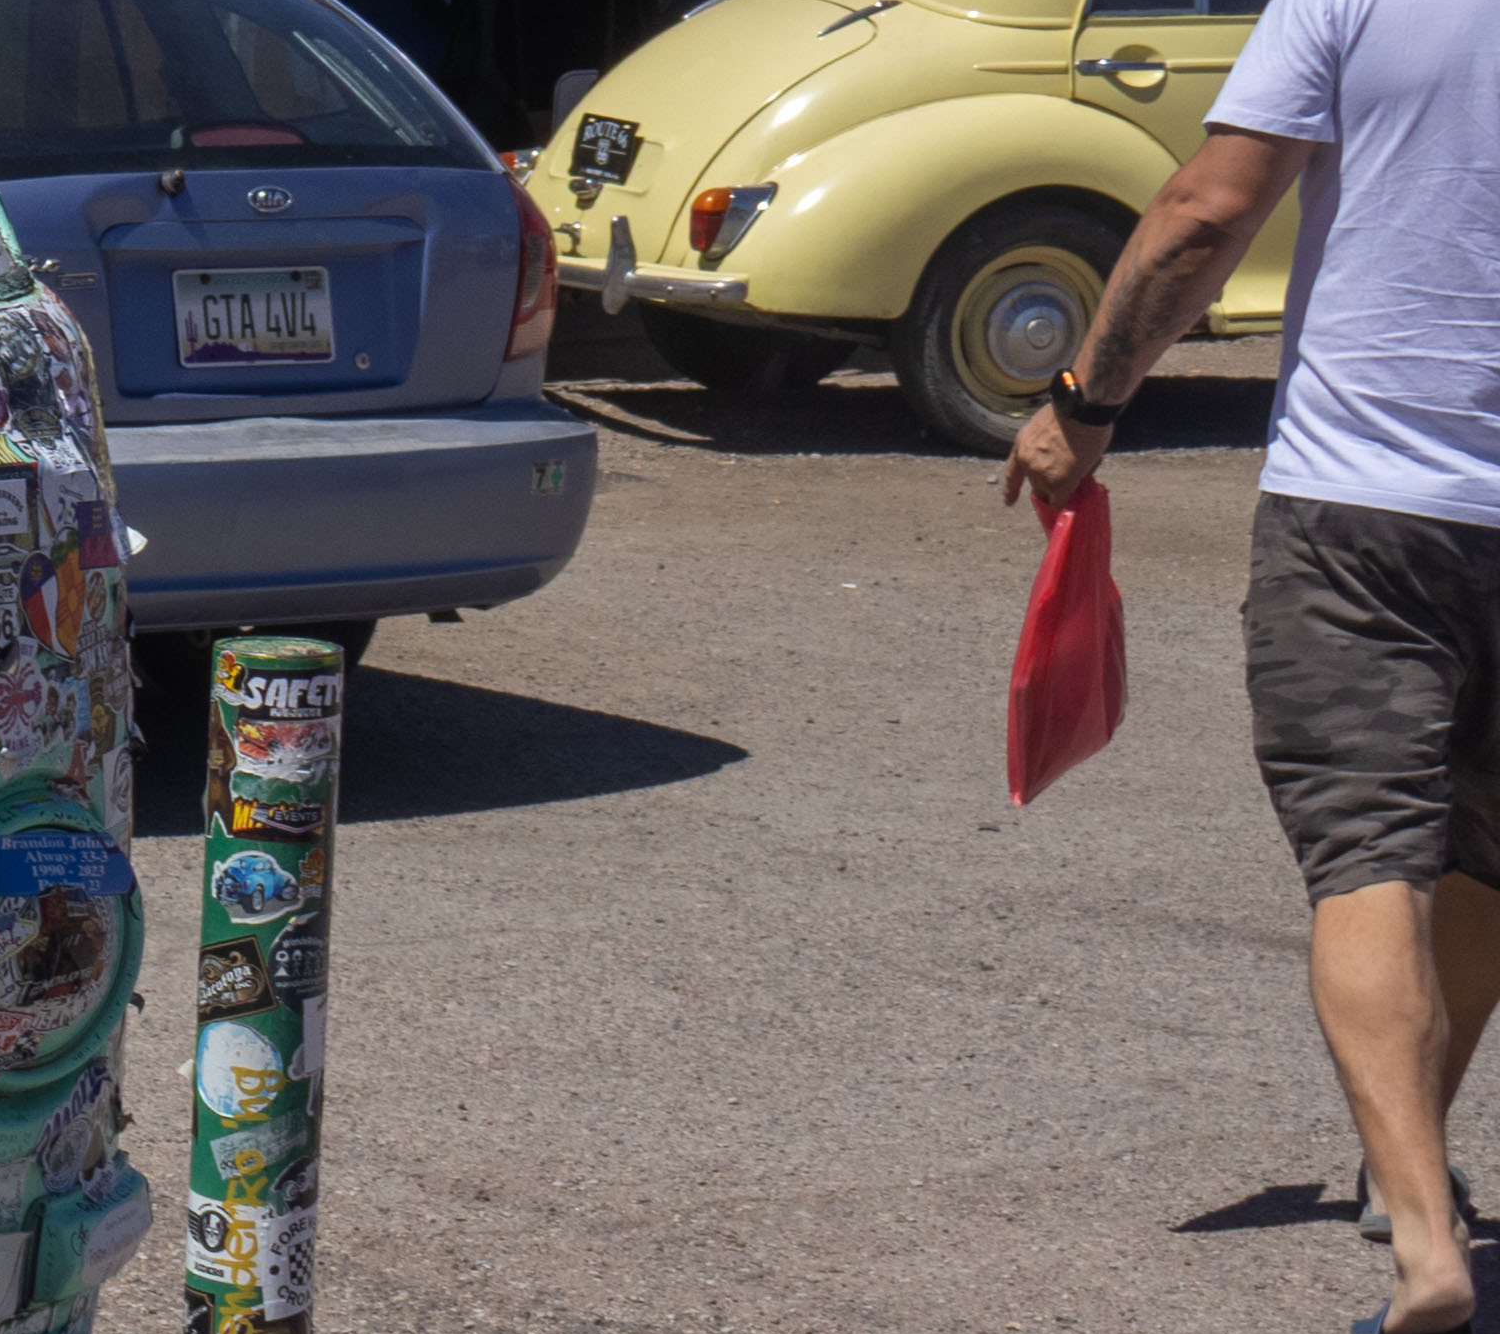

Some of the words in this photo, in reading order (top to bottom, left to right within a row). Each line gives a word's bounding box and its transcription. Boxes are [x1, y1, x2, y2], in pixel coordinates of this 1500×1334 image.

[583, 121, 620, 142] ROUTE
[202, 293, 256, 341] GTA
[265, 292, 316, 338] 4V4
[274, 809, 319, 822] EVENTS
[31, 865, 65, 877] 1990
